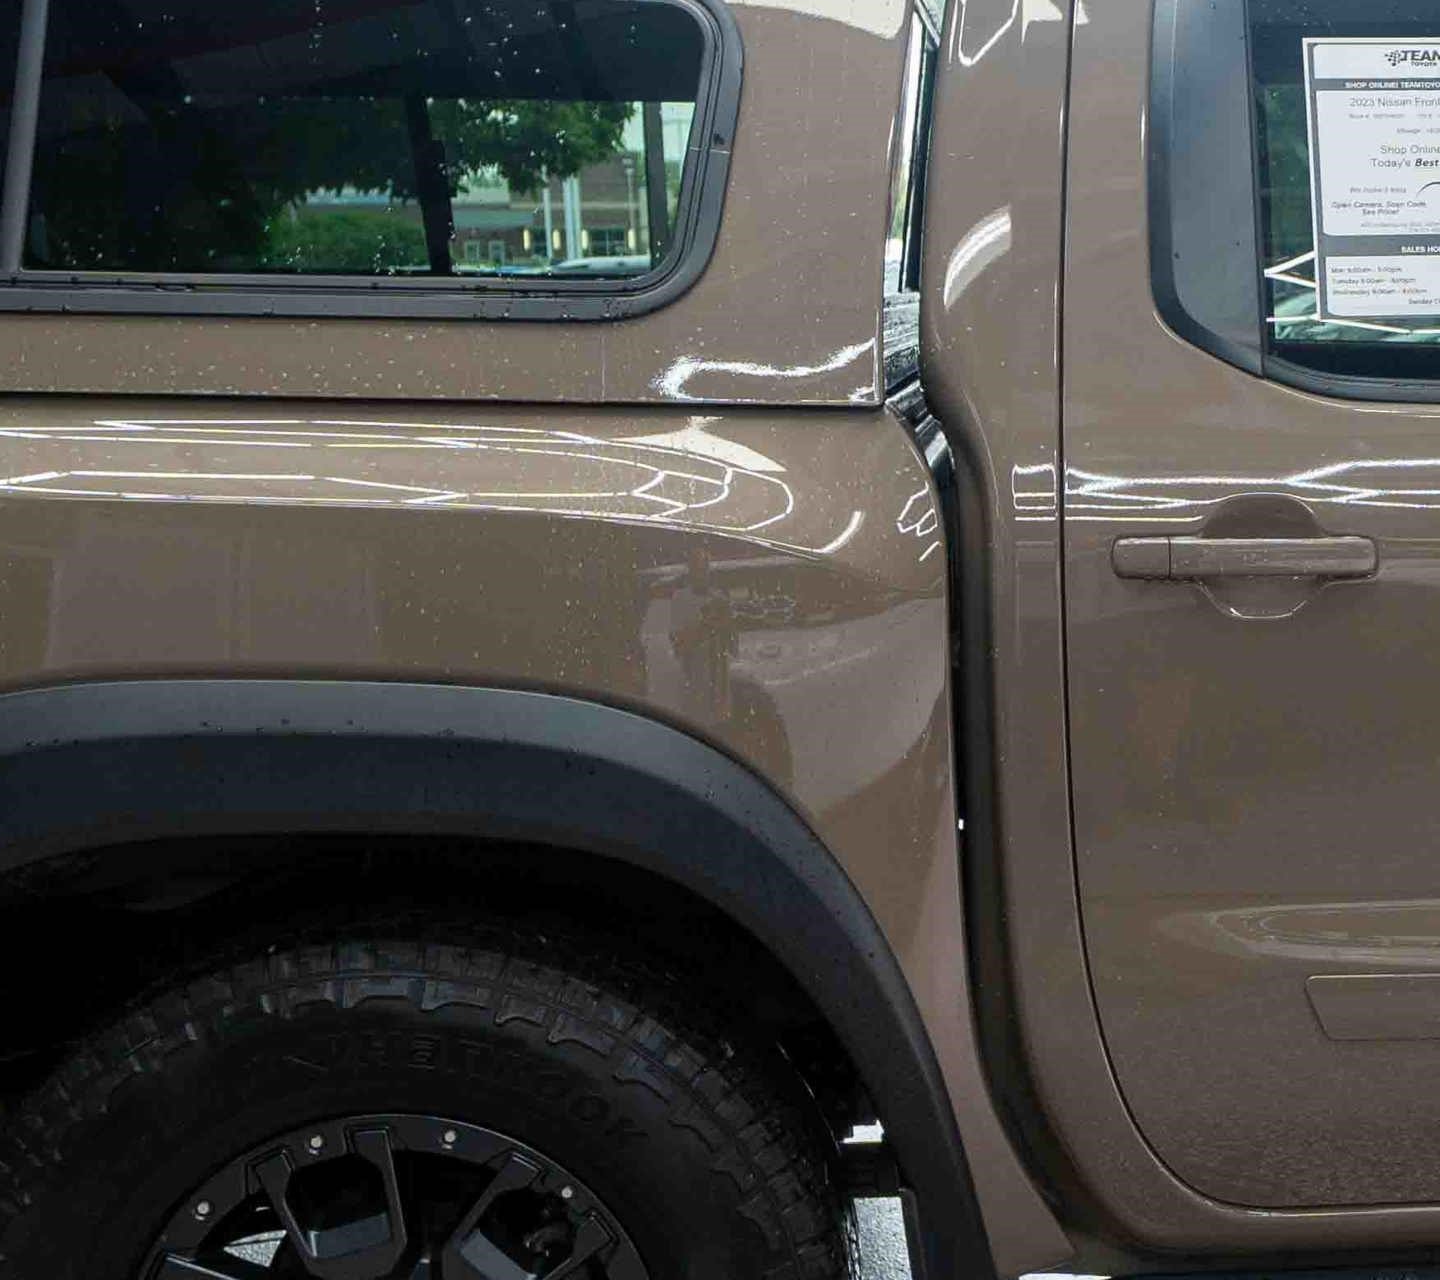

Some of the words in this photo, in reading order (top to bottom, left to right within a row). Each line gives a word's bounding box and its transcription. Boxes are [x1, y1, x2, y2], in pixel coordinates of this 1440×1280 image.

[1345, 81, 1368, 89] SHOP
[1349, 97, 1375, 107] 2023
[1377, 96, 1412, 107] Nissan
[1380, 145, 1407, 156] Shop
[1371, 158, 1411, 169] Today's
[1414, 158, 1439, 167] Best
[1401, 245, 1426, 253] SALES
